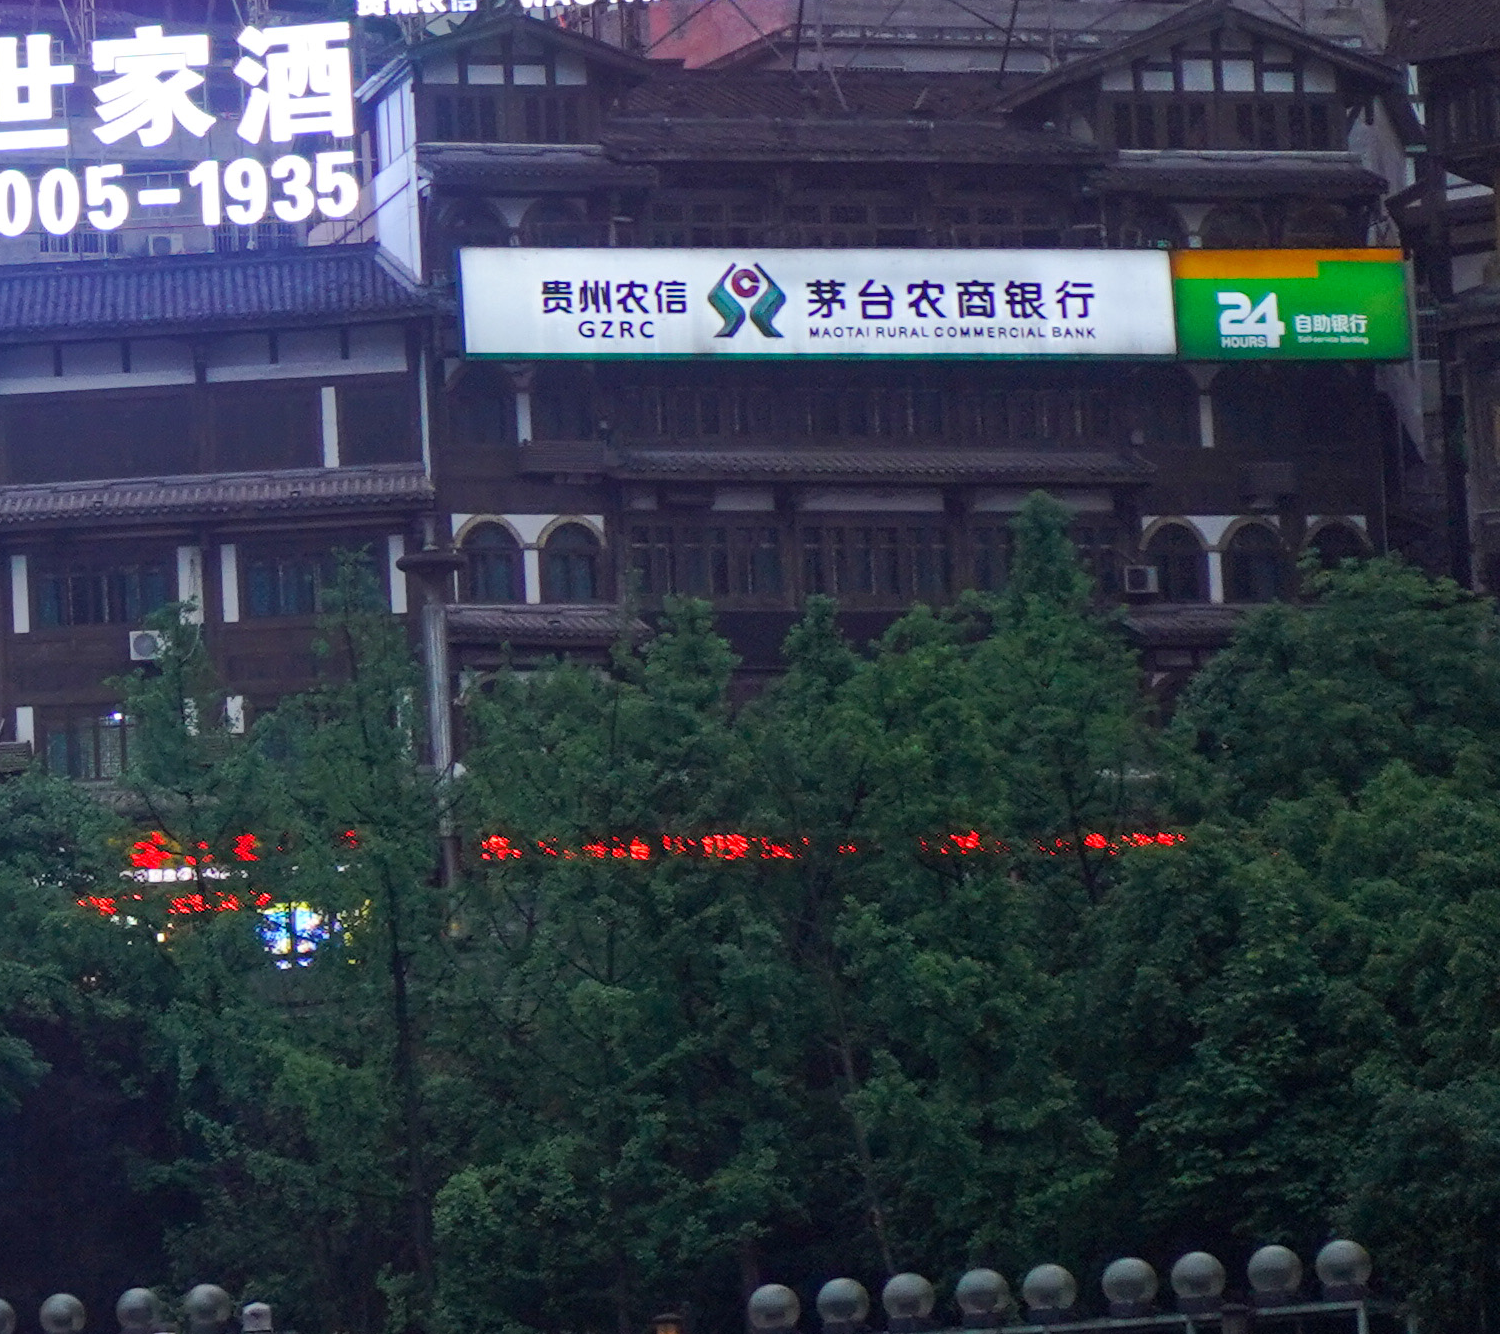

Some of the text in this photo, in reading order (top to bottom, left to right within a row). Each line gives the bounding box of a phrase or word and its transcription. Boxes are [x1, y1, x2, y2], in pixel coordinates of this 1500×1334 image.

[541, 279, 688, 315] 贵州农信
[805, 278, 1096, 321] 茅台农商银行
[577, 320, 656, 339] GZRC
[1216, 291, 1286, 349] 24
[1293, 313, 1369, 334] 自助银行
[809, 325, 1097, 340] MAOTAI RURAL COMMERCIAL BANK
[1220, 335, 1268, 349] HOURS
